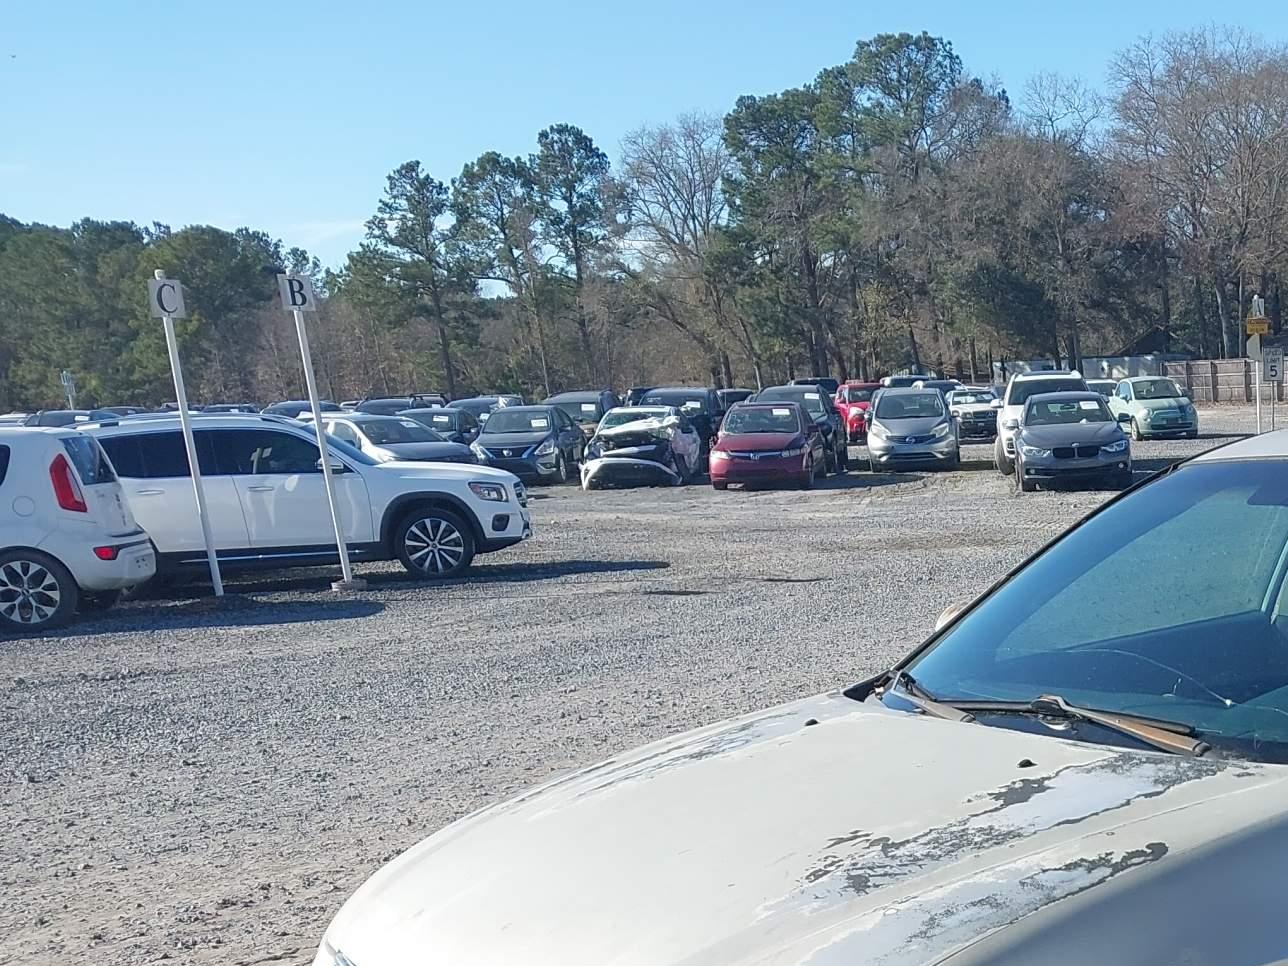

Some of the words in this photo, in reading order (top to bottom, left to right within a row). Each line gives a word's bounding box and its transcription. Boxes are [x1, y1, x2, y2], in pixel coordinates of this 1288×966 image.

[156, 283, 178, 314] C
[286, 278, 308, 307] B
[1269, 365, 1278, 377] 5
